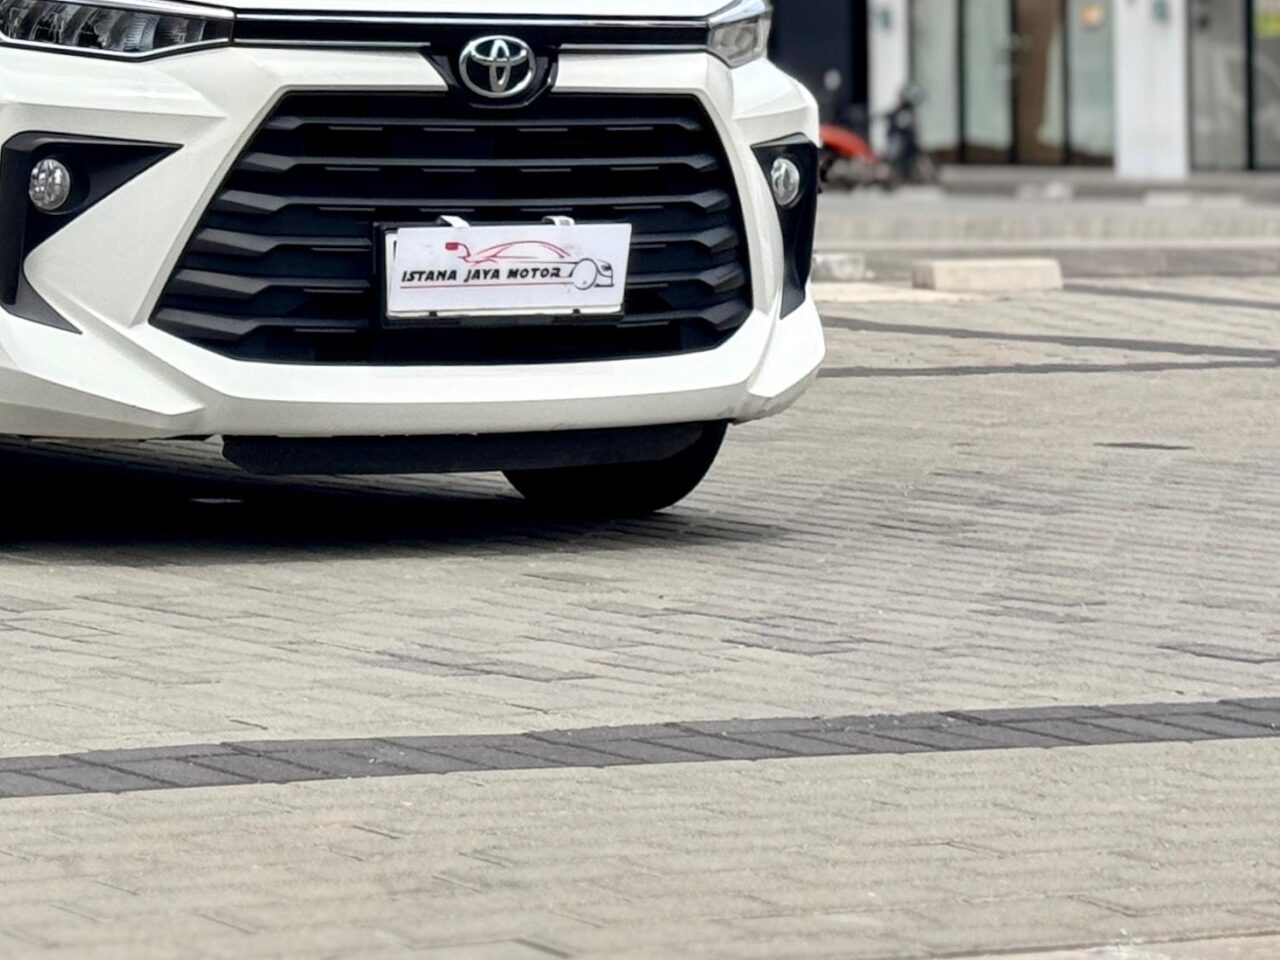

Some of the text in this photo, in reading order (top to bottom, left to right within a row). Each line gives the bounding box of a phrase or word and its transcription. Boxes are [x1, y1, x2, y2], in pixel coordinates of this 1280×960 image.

[401, 266, 562, 283] ISTANA JAYA MOTOR
